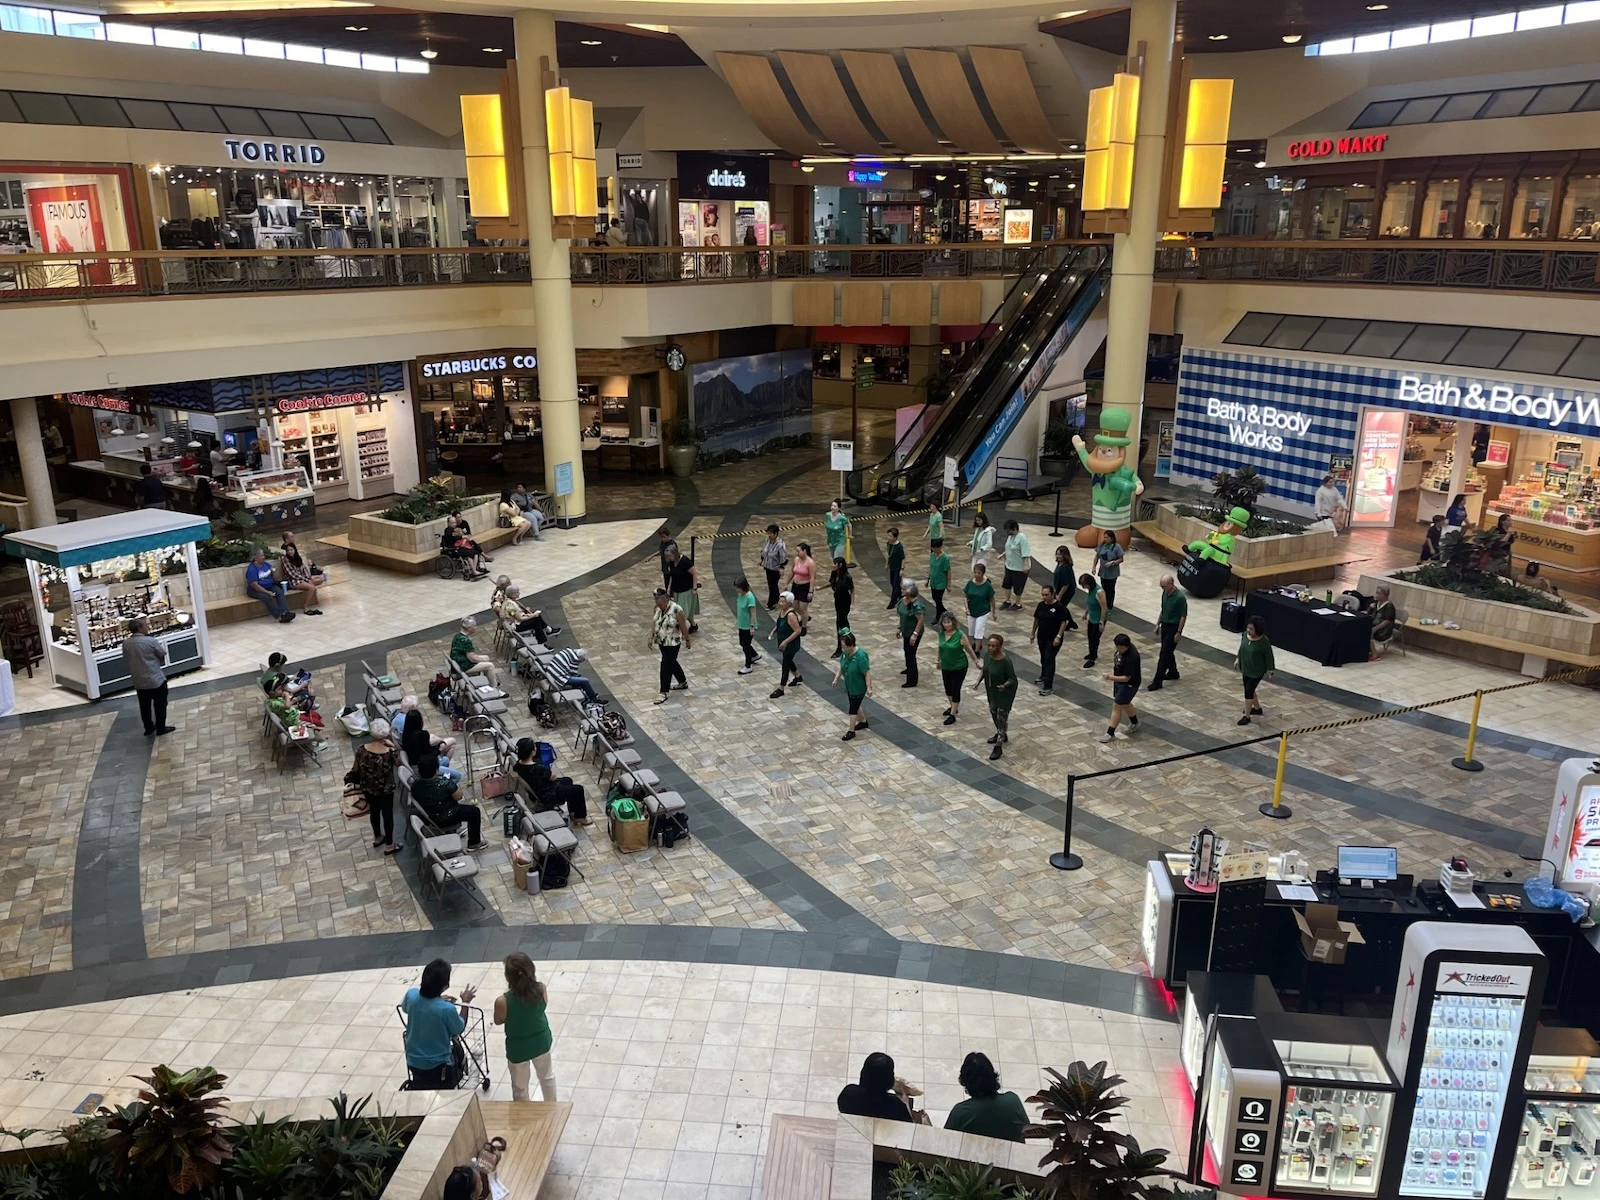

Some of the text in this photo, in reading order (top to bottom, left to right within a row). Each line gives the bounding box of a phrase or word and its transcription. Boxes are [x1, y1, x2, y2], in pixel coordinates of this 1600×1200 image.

[225, 141, 326, 164] TORRID
[1287, 134, 1387, 158] GOLD MART
[620, 157, 641, 165] TORRID
[708, 169, 746, 187] claire's
[49, 203, 87, 219] FAMOUS
[423, 355, 537, 377] STARBUCKS CO
[98, 395, 130, 412] Corner
[279, 392, 366, 411] Cookie Corner
[1399, 375, 1461, 407] Bath
[1463, 383, 1486, 410] &
[1489, 385, 1573, 427] Body
[984, 397, 1018, 447] You Can Join!
[1207, 397, 1312, 436] Bath & Body
[1229, 423, 1284, 452] Works
[1520, 532, 1545, 546] Body
[1546, 538, 1575, 553] Works
[1465, 973, 1511, 983] TrickedOut
